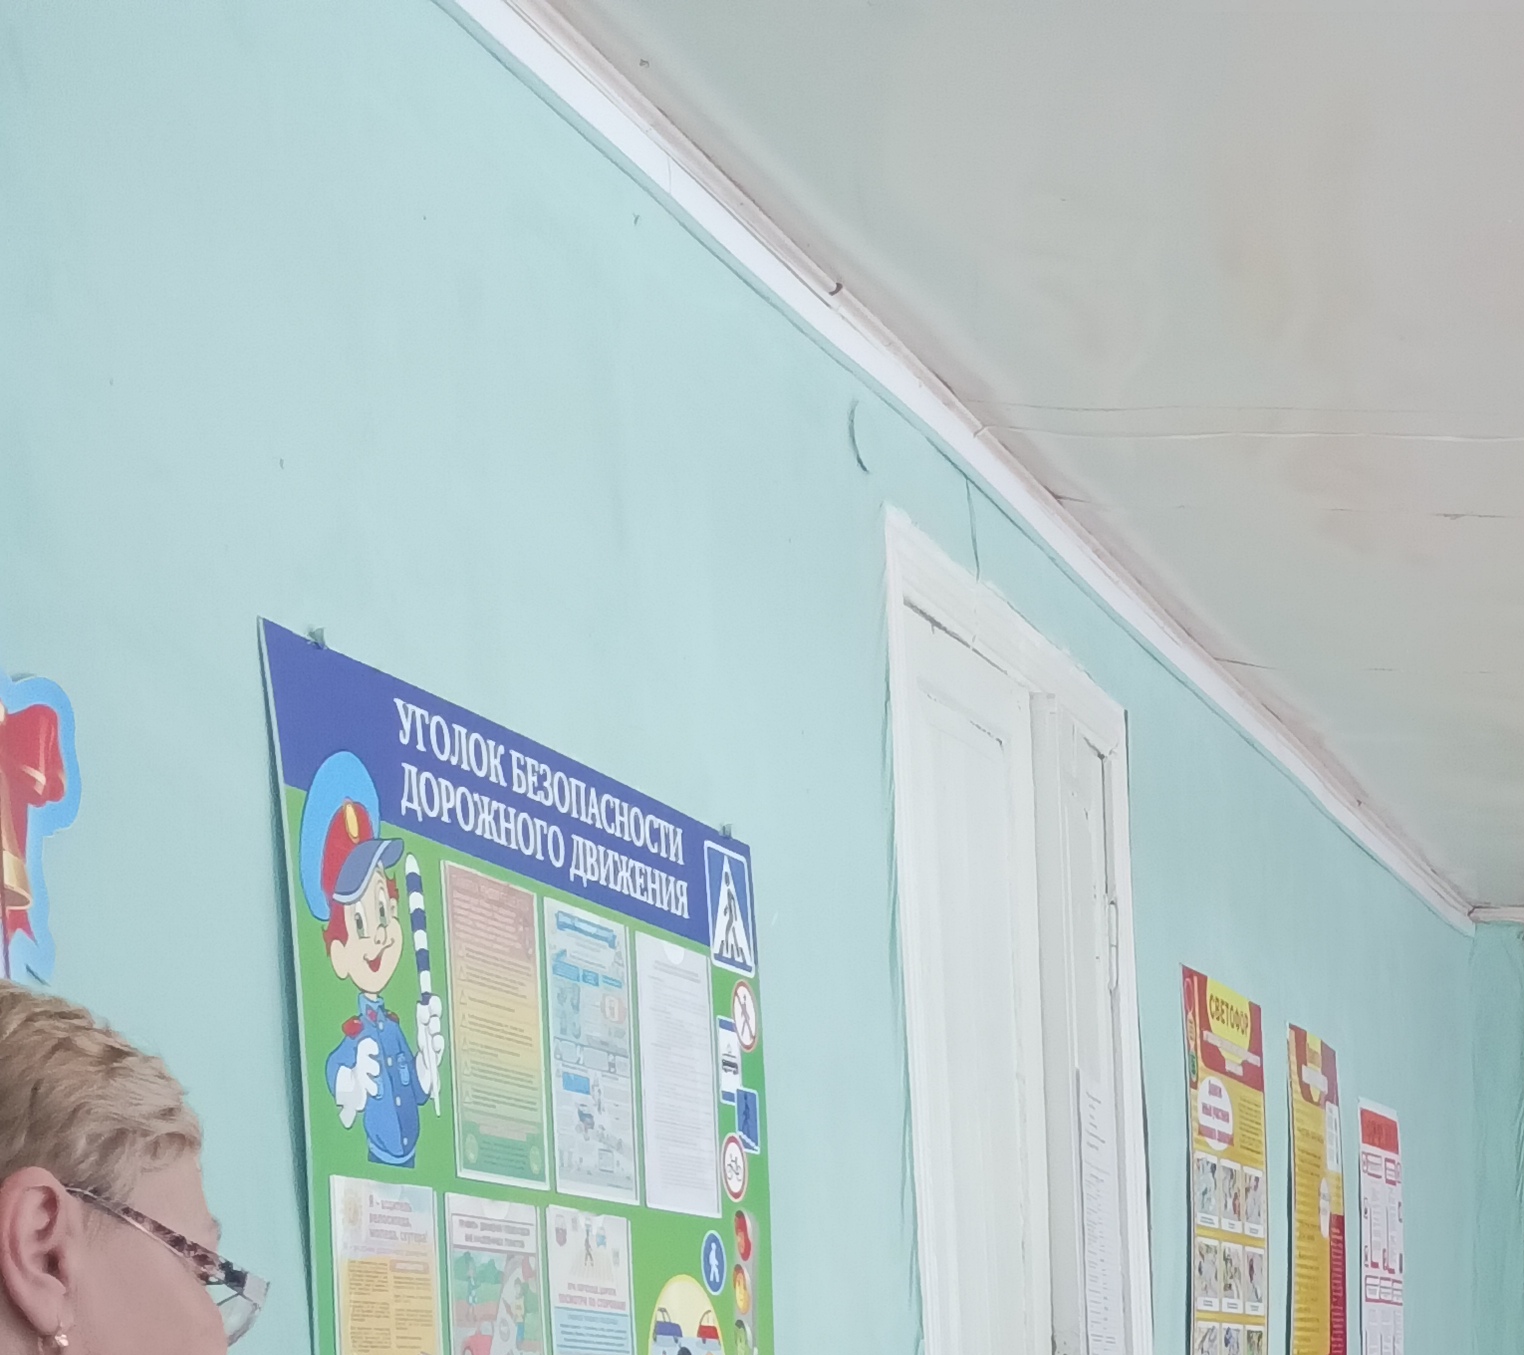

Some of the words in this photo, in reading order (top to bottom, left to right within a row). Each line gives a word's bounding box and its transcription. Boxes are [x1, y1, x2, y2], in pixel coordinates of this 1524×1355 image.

[393, 698, 507, 787] УГОЛОК
[509, 749, 685, 865] БЕЗОПАСНОСТИ
[401, 763, 565, 868] ДОРОЖНОГО
[569, 834, 690, 919] ДВИЖЕНИЯ
[1209, 993, 1249, 1037] СВЕТОФОР
